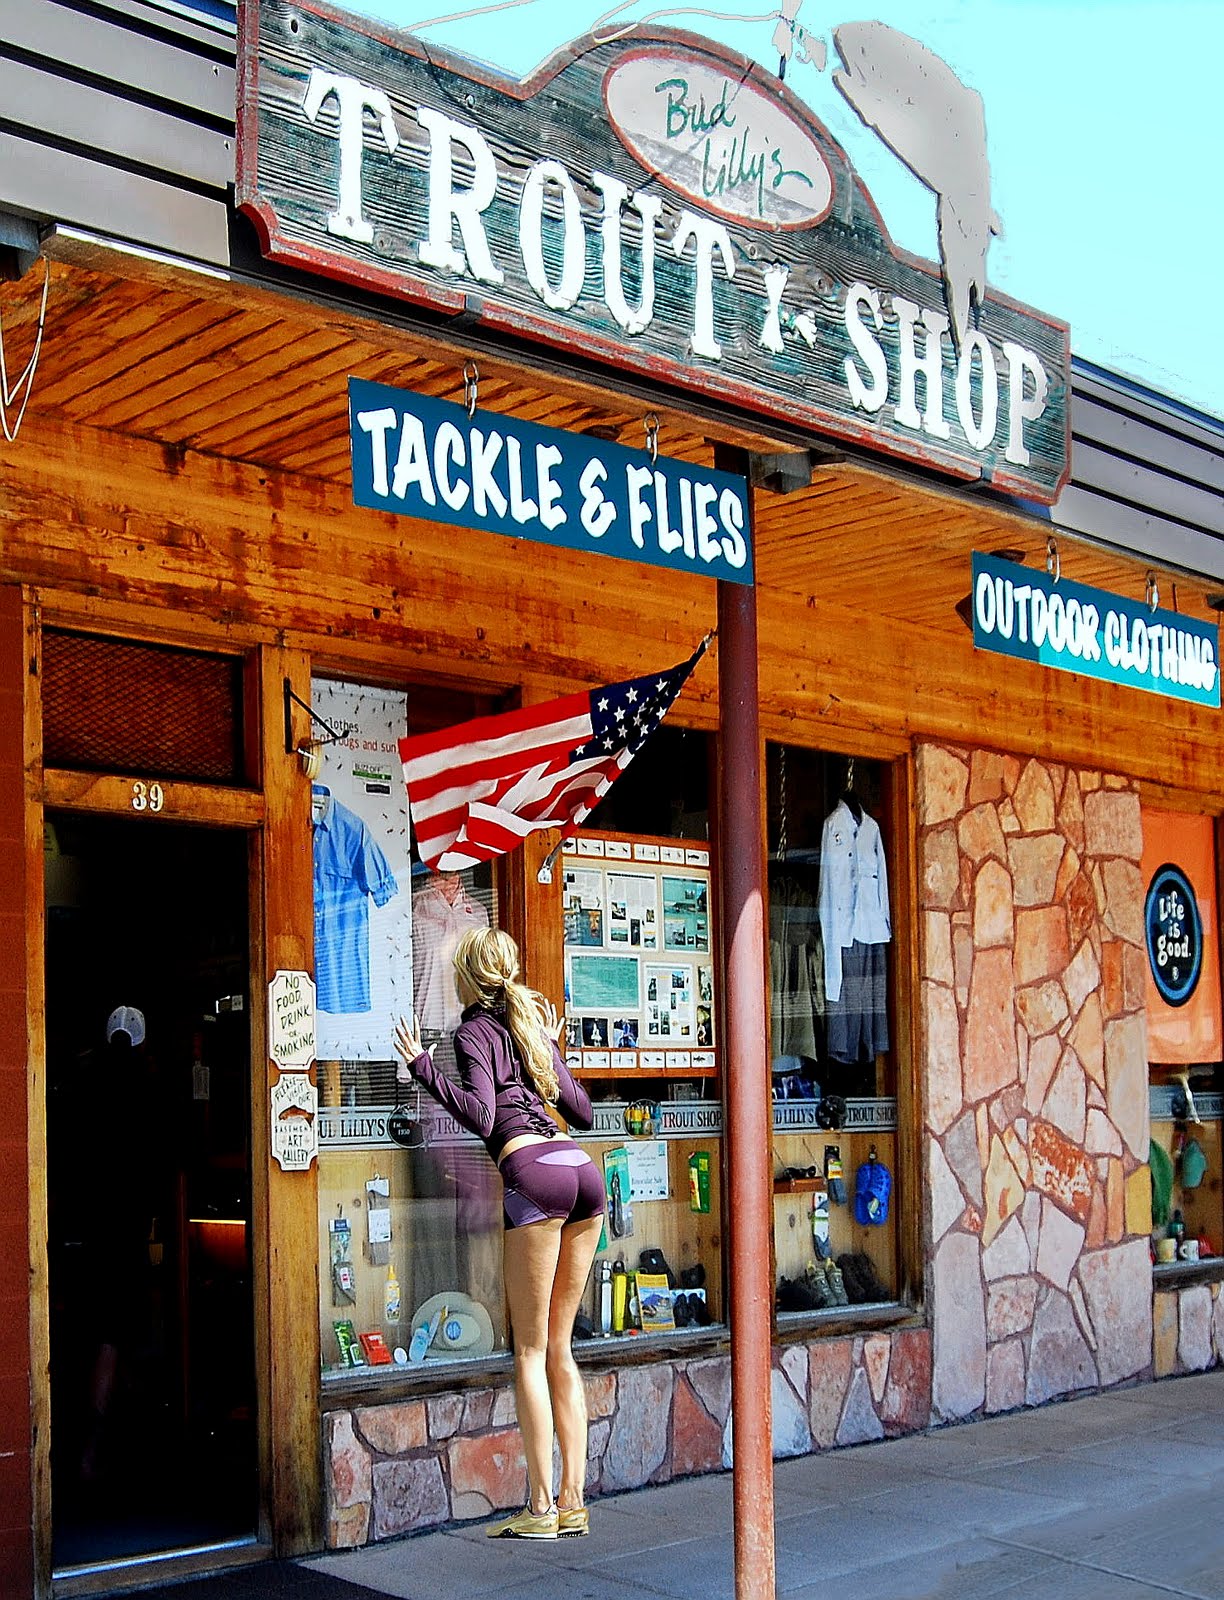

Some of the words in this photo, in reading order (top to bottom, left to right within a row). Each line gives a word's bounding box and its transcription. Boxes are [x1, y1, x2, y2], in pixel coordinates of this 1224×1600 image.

[655, 79, 736, 138] Bud
[302, 67, 736, 361] TROUT
[844, 281, 1048, 467] SHOP
[357, 406, 567, 532] TACKLE
[578, 458, 617, 538] &
[625, 463, 747, 570] FLIES
[975, 572, 1101, 662] OUTDOOR
[1104, 610, 1217, 692] CLOTHING
[363, 741, 378, 752] and
[381, 742, 397, 753] sun
[132, 781, 164, 812] 39
[1158, 890, 1185, 922] Life
[1167, 919, 1181, 938] is
[1157, 933, 1192, 967] good.
[285, 972, 300, 990] NO
[280, 1003, 313, 1030] DRINK
[273, 1032, 315, 1057] SMOKING
[592, 1113, 621, 1130] LLY'S
[662, 1111, 695, 1129] TROUT
[697, 1110, 721, 1128] SHOP
[784, 1106, 815, 1124] LILLY'S
[848, 1106, 875, 1122] TROUT
[274, 1125, 312, 1133] BASEMEN
[287, 1134, 303, 1147] ART
[318, 1120, 337, 1139] UD
[340, 1118, 385, 1138] LILLY'S
[436, 1117, 468, 1135] TRO
